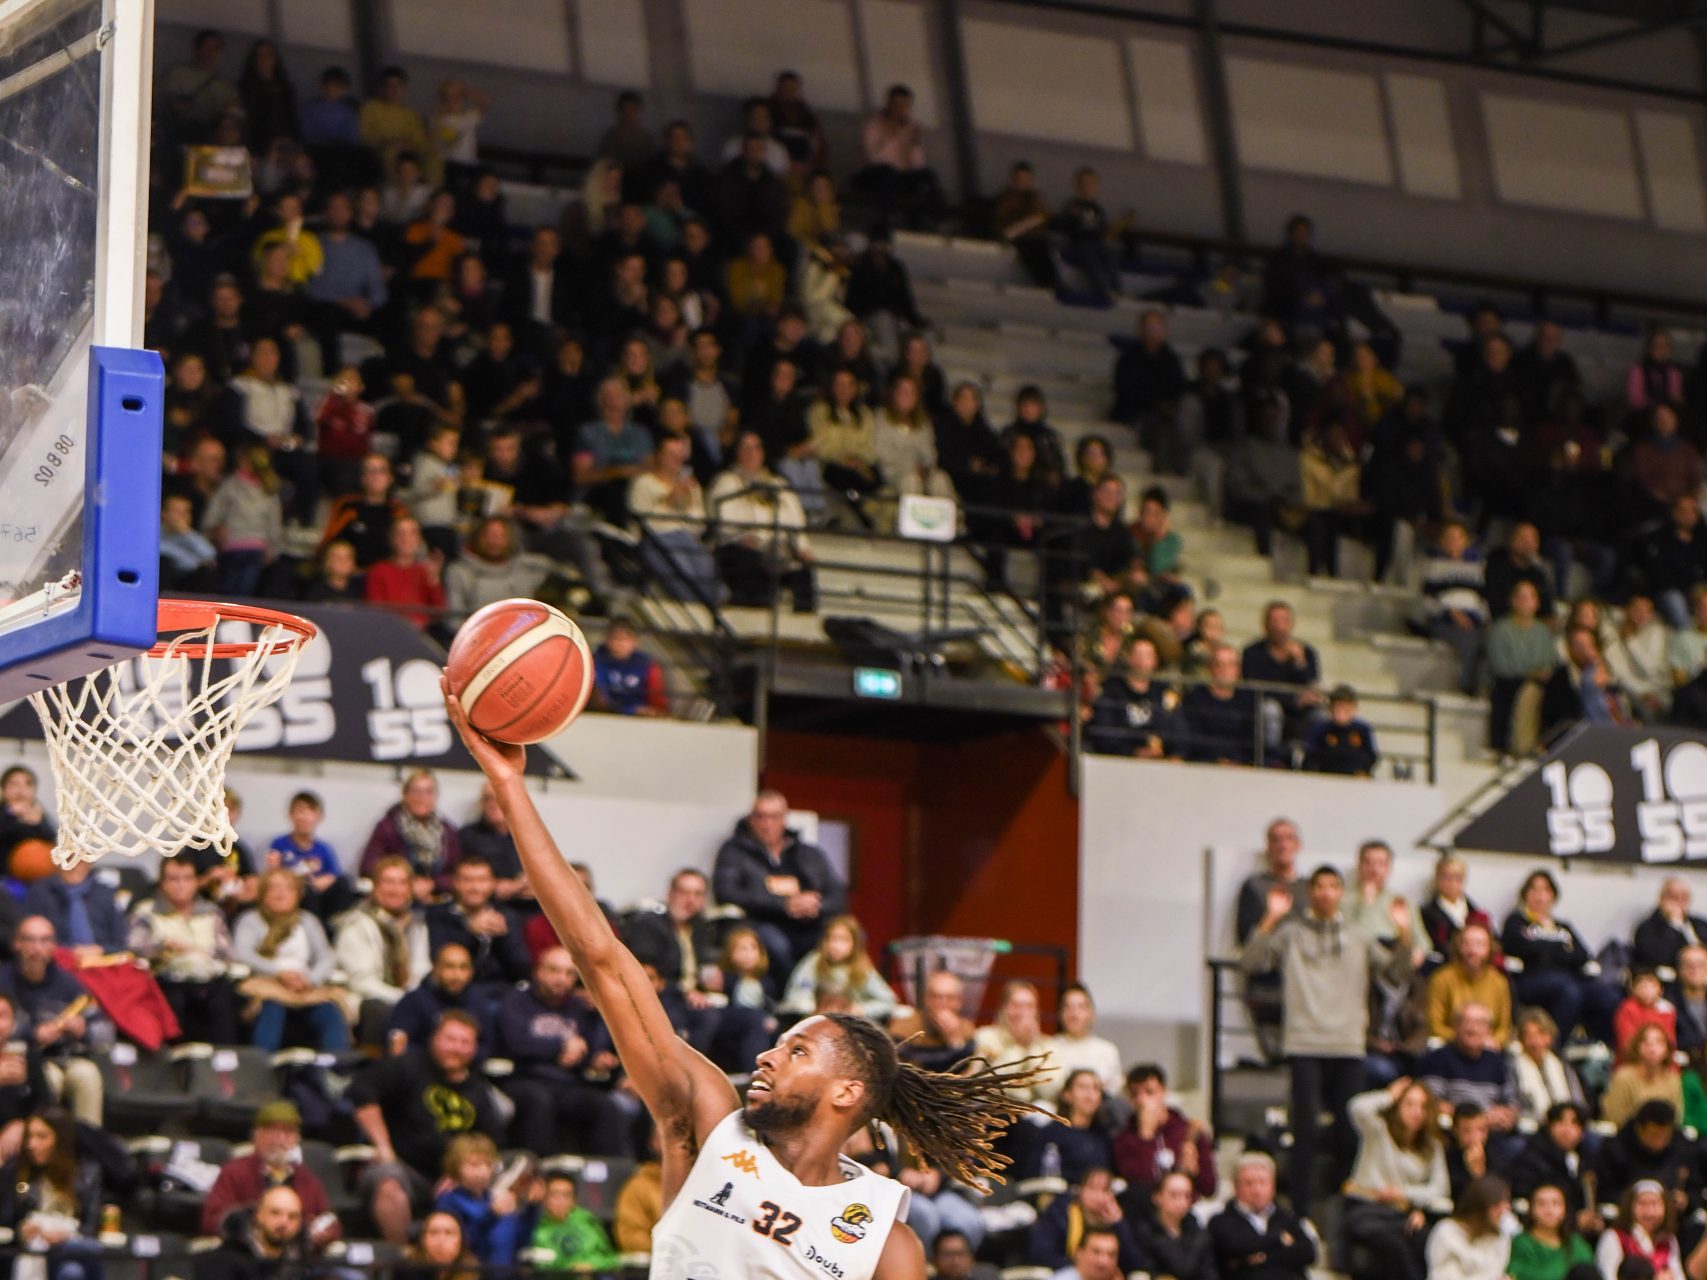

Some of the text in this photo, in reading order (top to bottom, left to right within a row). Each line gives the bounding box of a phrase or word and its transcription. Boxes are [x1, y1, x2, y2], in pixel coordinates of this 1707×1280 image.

[366, 706, 453, 762] 55
[1546, 806, 1616, 857] 55
[752, 1200, 803, 1248] 32
